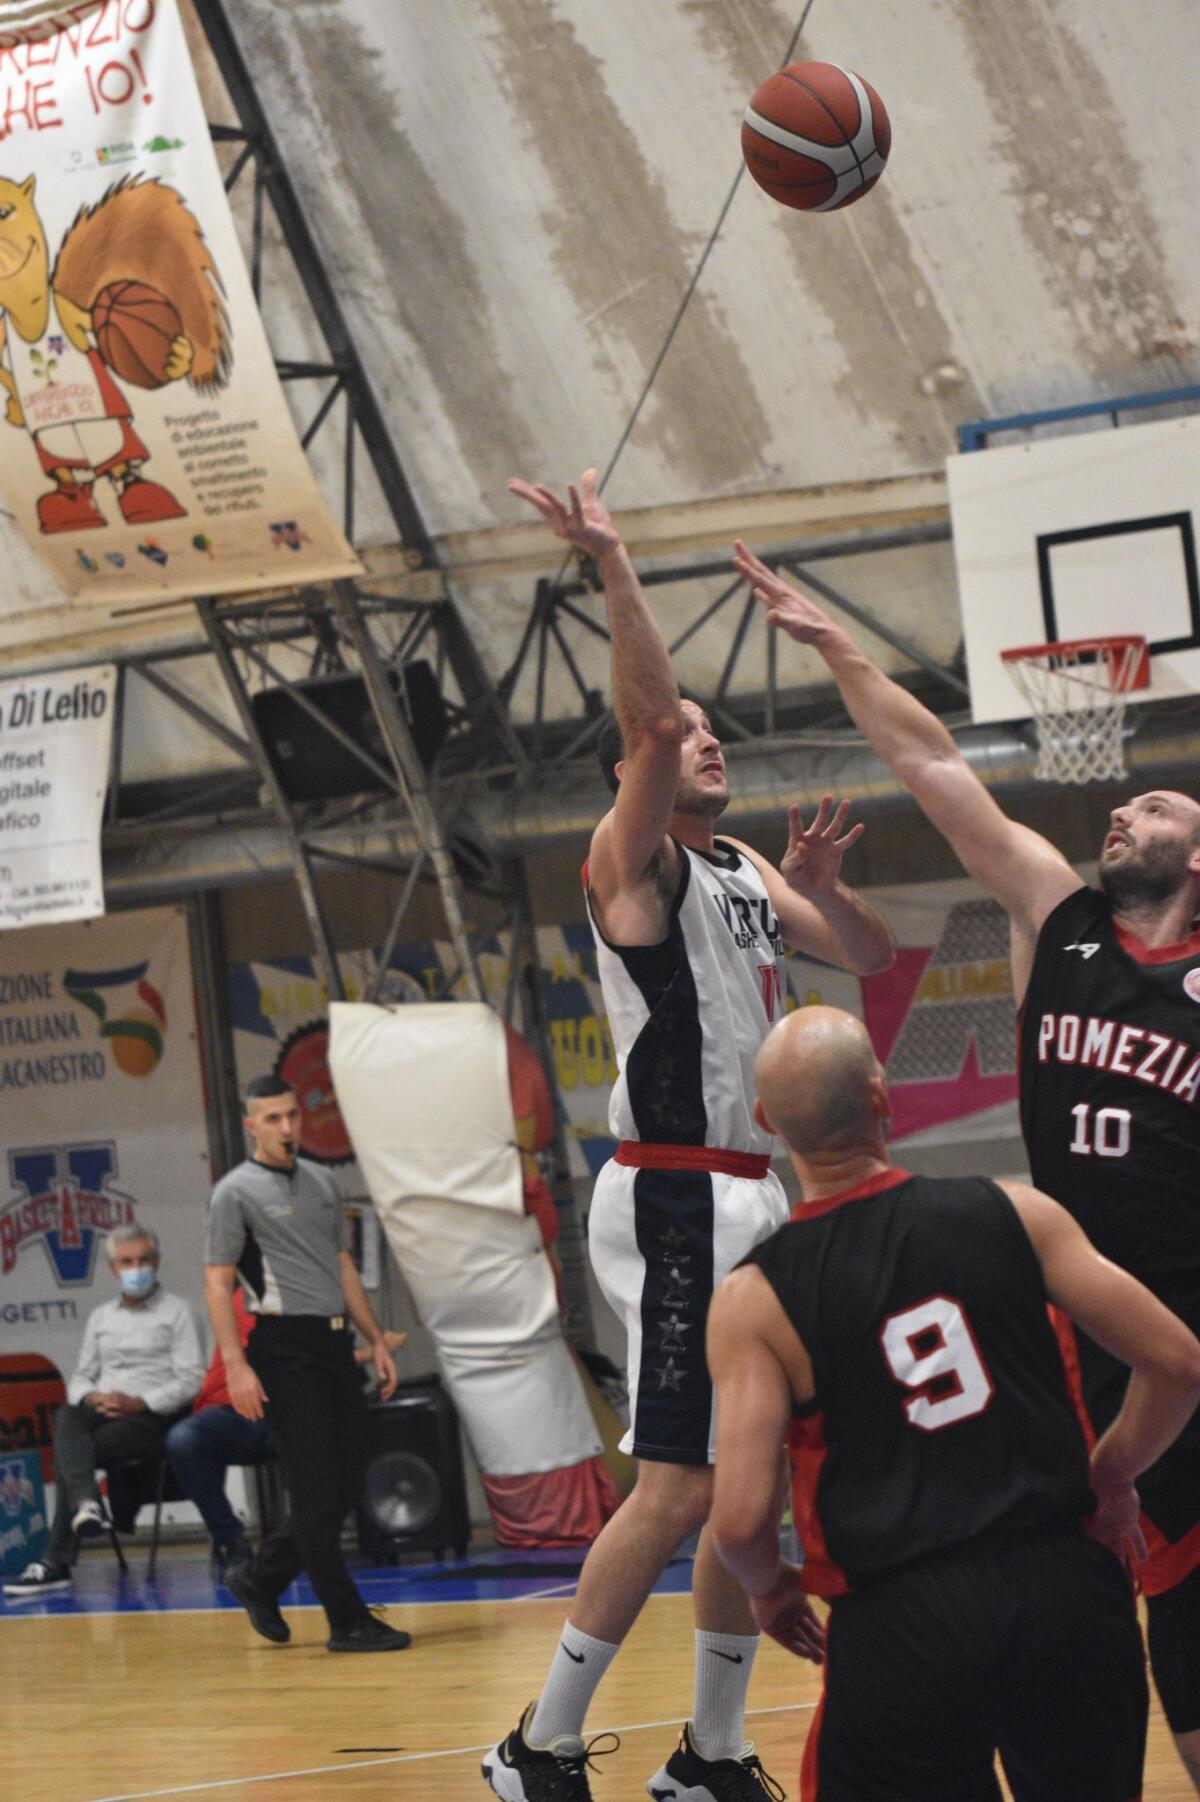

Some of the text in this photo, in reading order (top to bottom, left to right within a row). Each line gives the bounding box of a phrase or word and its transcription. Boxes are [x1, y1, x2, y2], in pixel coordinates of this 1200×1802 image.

[0, 48, 153, 141] HE IO!
[9, 681, 107, 728] Di Lelio
[1037, 1012, 1200, 1103] POMEZIA
[1068, 1103, 1132, 1158] 10
[2, 1300, 77, 1323] GETTI
[878, 1293, 994, 1434] 9
